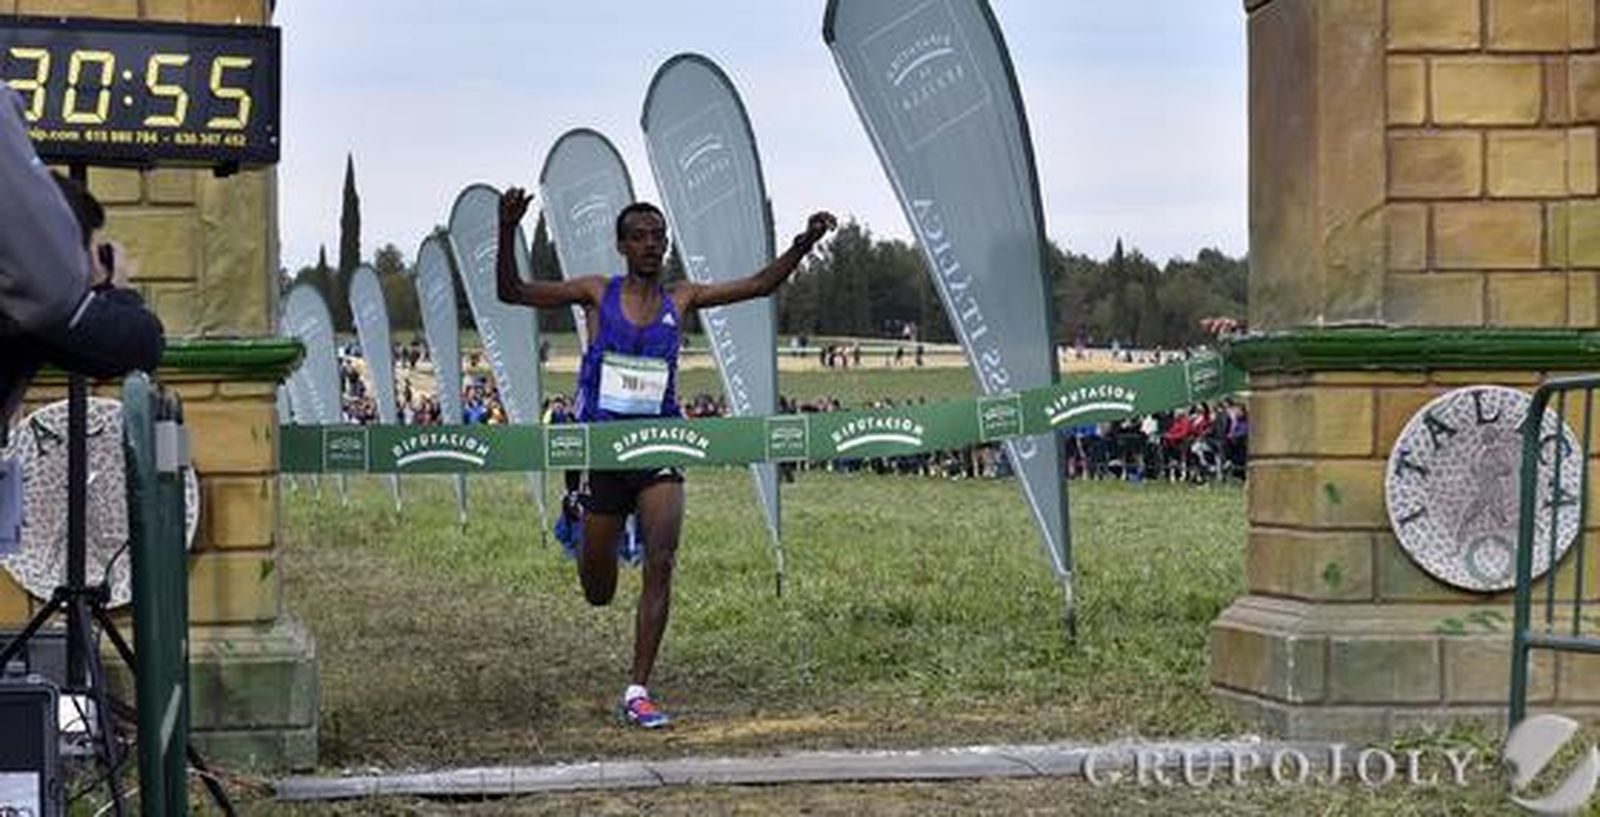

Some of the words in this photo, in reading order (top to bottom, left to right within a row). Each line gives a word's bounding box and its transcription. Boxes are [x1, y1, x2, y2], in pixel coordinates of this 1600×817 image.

[7, 47, 253, 130] 30:55
[391, 433, 490, 458] DIPUTACION
[612, 426, 711, 454] DIPUTACION
[1394, 390, 1578, 528] ITALCA
